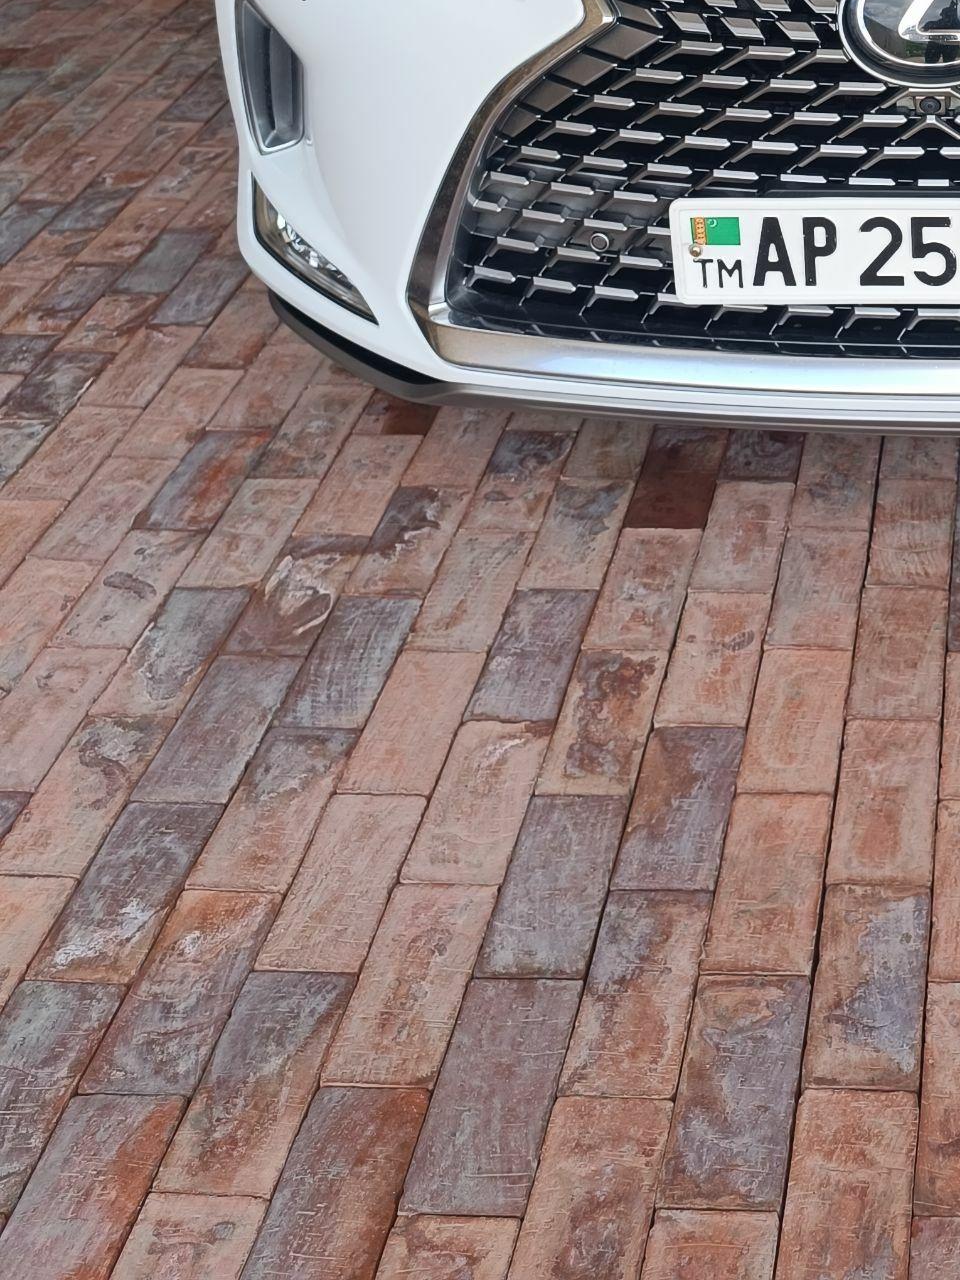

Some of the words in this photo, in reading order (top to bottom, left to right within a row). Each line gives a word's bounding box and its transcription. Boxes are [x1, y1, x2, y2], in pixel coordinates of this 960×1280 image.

[693, 258, 744, 289] TM
[752, 216, 837, 287] AP
[859, 216, 958, 287] 25
